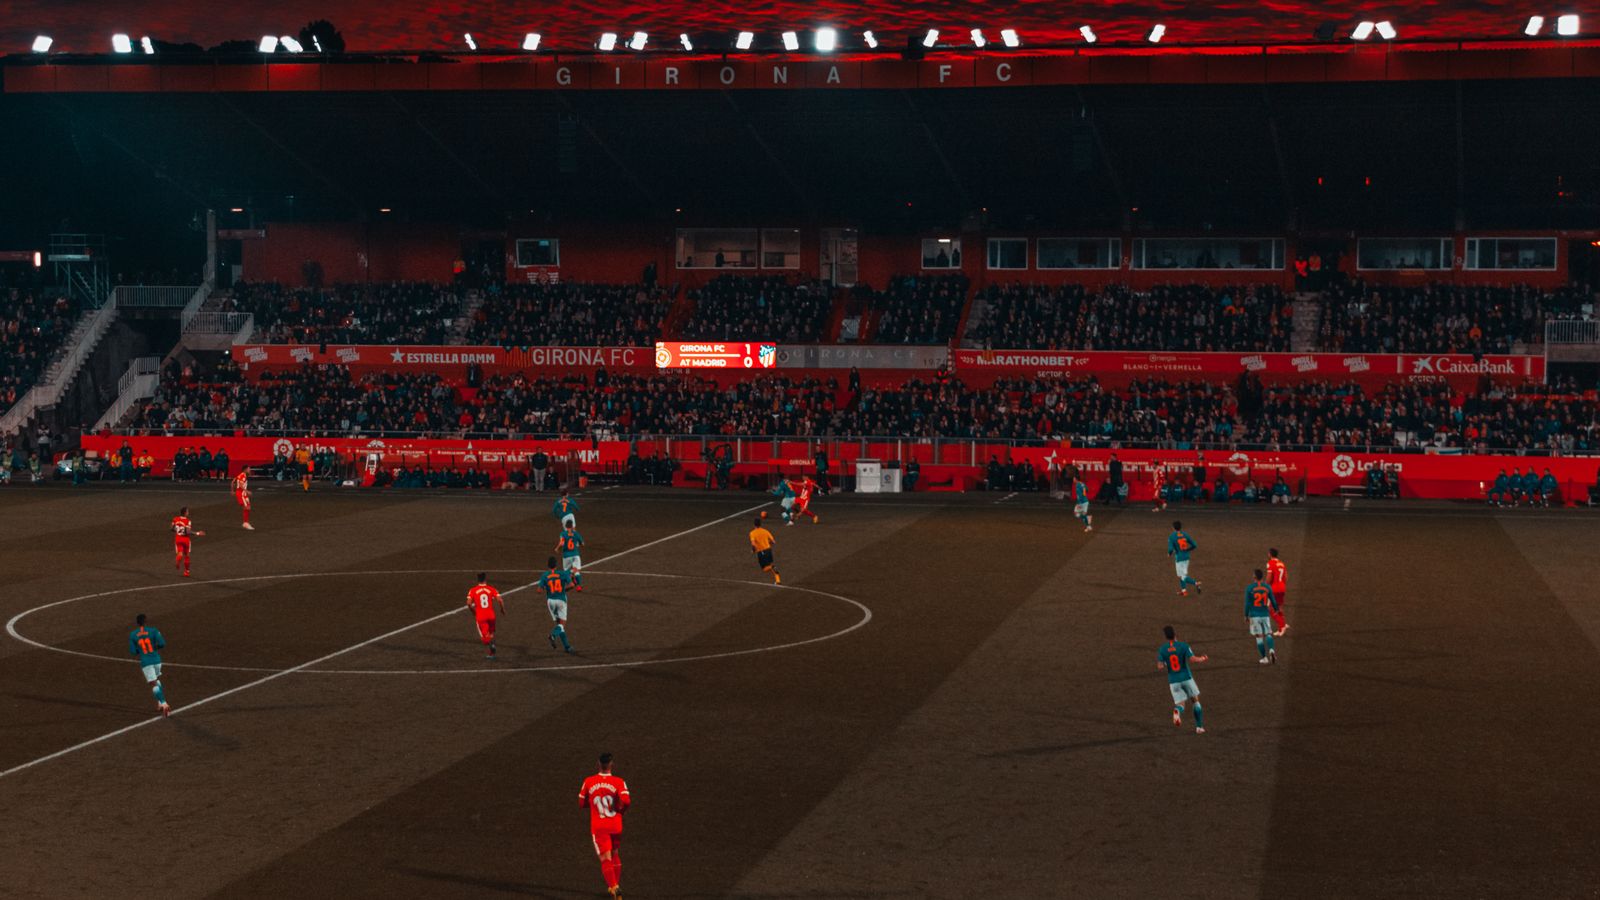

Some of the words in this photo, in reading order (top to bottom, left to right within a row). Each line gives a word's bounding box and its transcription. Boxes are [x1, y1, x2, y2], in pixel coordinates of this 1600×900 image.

[556, 66, 841, 84] GIRONA
[939, 62, 1013, 83] FC
[680, 344, 712, 353] GIRONA
[714, 344, 726, 353] FC
[744, 343, 751, 355] 1
[407, 353, 459, 363] ESTRELLA
[461, 353, 496, 364] DAMM
[532, 349, 605, 366] GIRONA
[611, 349, 635, 366] FC
[680, 358, 691, 367] AT
[692, 358, 727, 367] MADRID
[743, 356, 753, 368] 0
[976, 355, 1075, 367] MARATHONBET
[1435, 357, 1516, 374] CaixaBank
[567, 538, 575, 550] 6
[1278, 568, 1284, 581] 7
[548, 580, 562, 593] 14
[480, 594, 489, 608] 8
[1254, 593, 1267, 606] 21
[138, 638, 153, 654] 11
[1169, 655, 1180, 671] 8
